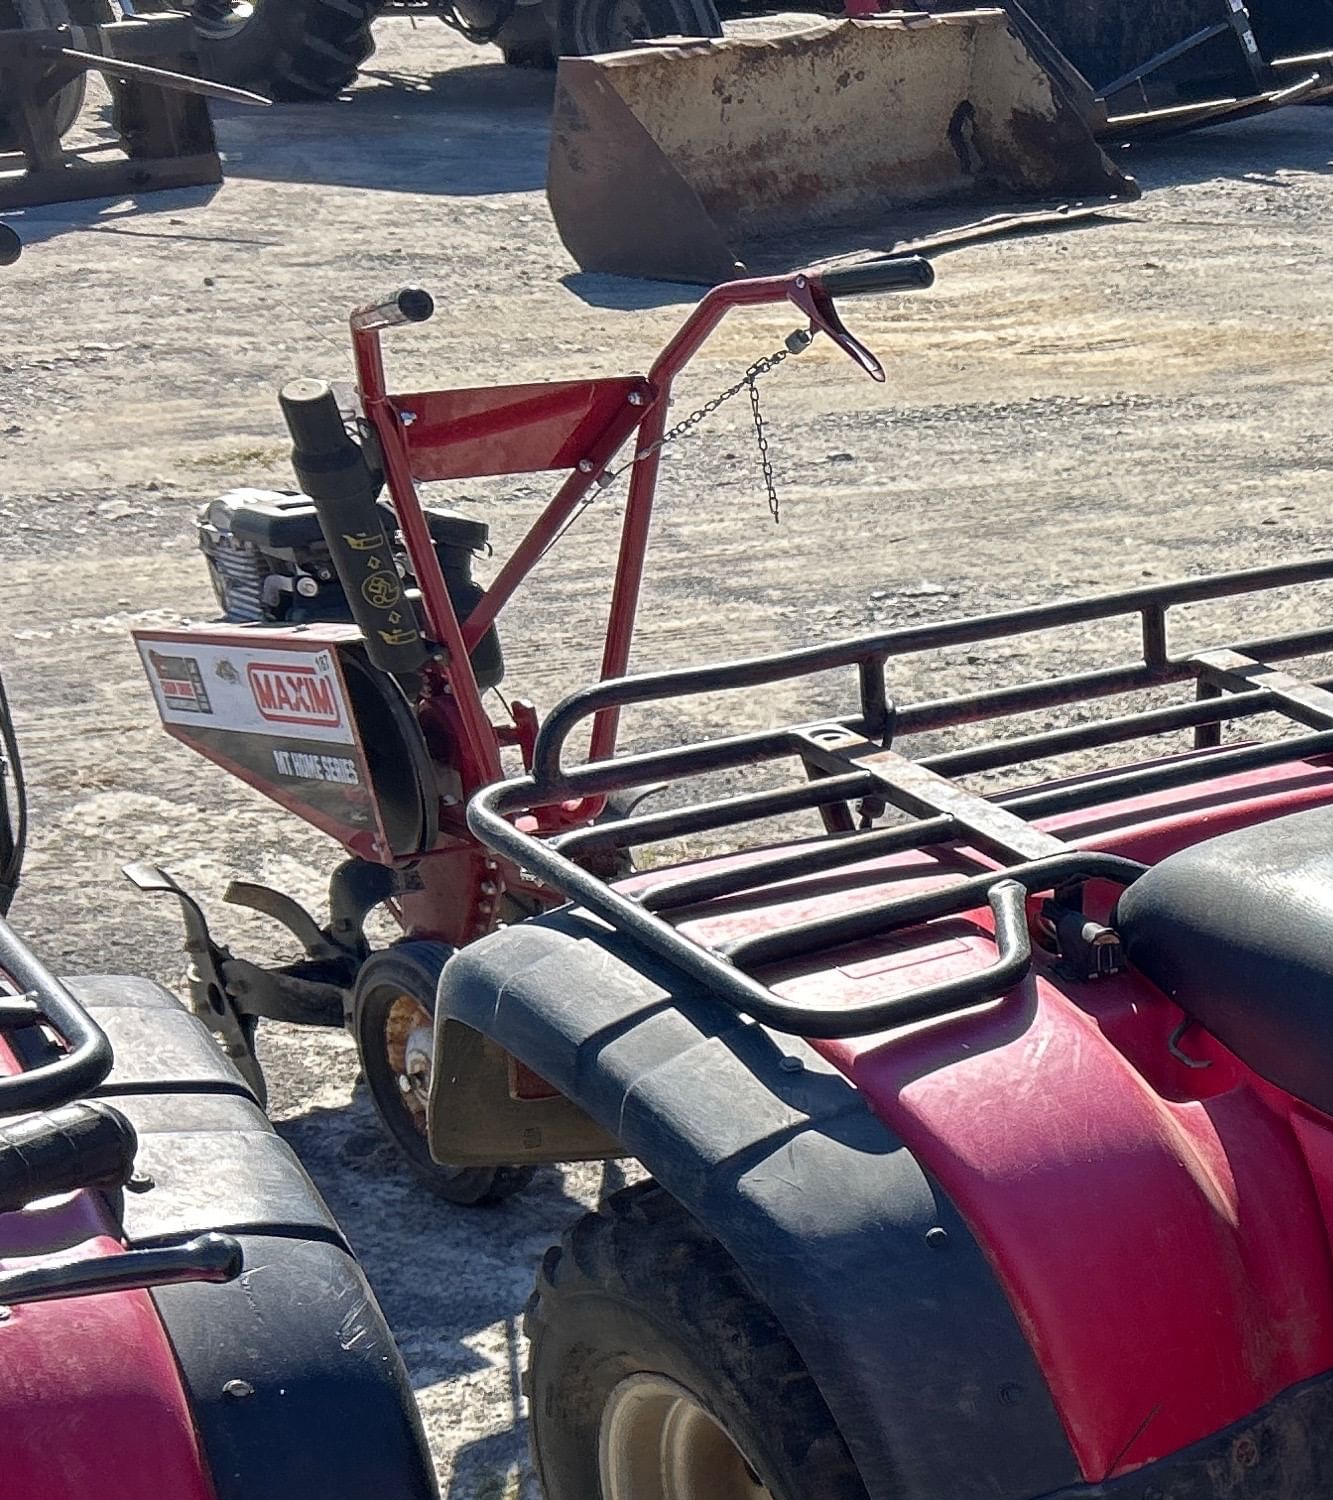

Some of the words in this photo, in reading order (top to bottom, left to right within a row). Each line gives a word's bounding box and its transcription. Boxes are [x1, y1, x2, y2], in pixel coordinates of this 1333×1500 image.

[251, 672, 336, 717] MAXIM
[291, 752, 322, 780] HOME
[320, 756, 359, 785] SERIES
